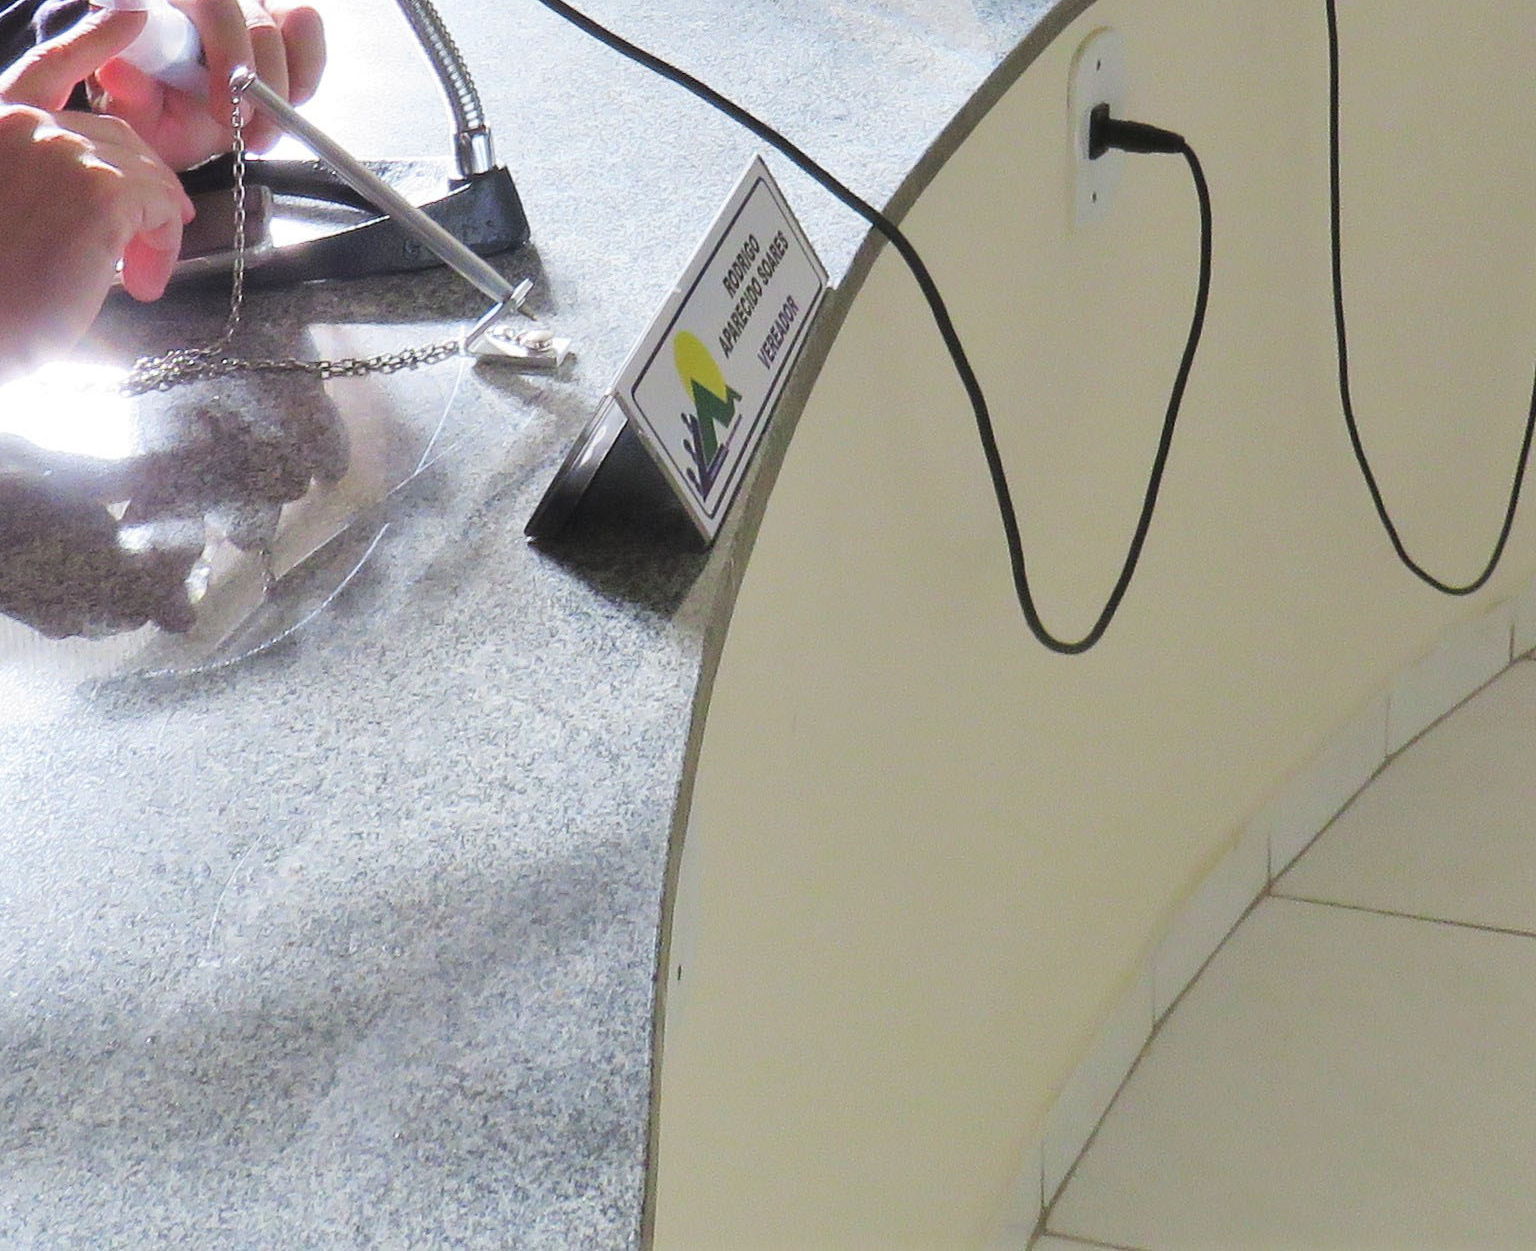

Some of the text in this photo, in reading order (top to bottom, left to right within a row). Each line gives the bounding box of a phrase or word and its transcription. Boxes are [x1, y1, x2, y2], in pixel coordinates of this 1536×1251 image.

[719, 230, 789, 360] APARECIDO SOARES
[722, 233, 760, 299] RODRIGO
[757, 294, 799, 371] VEREADOR
